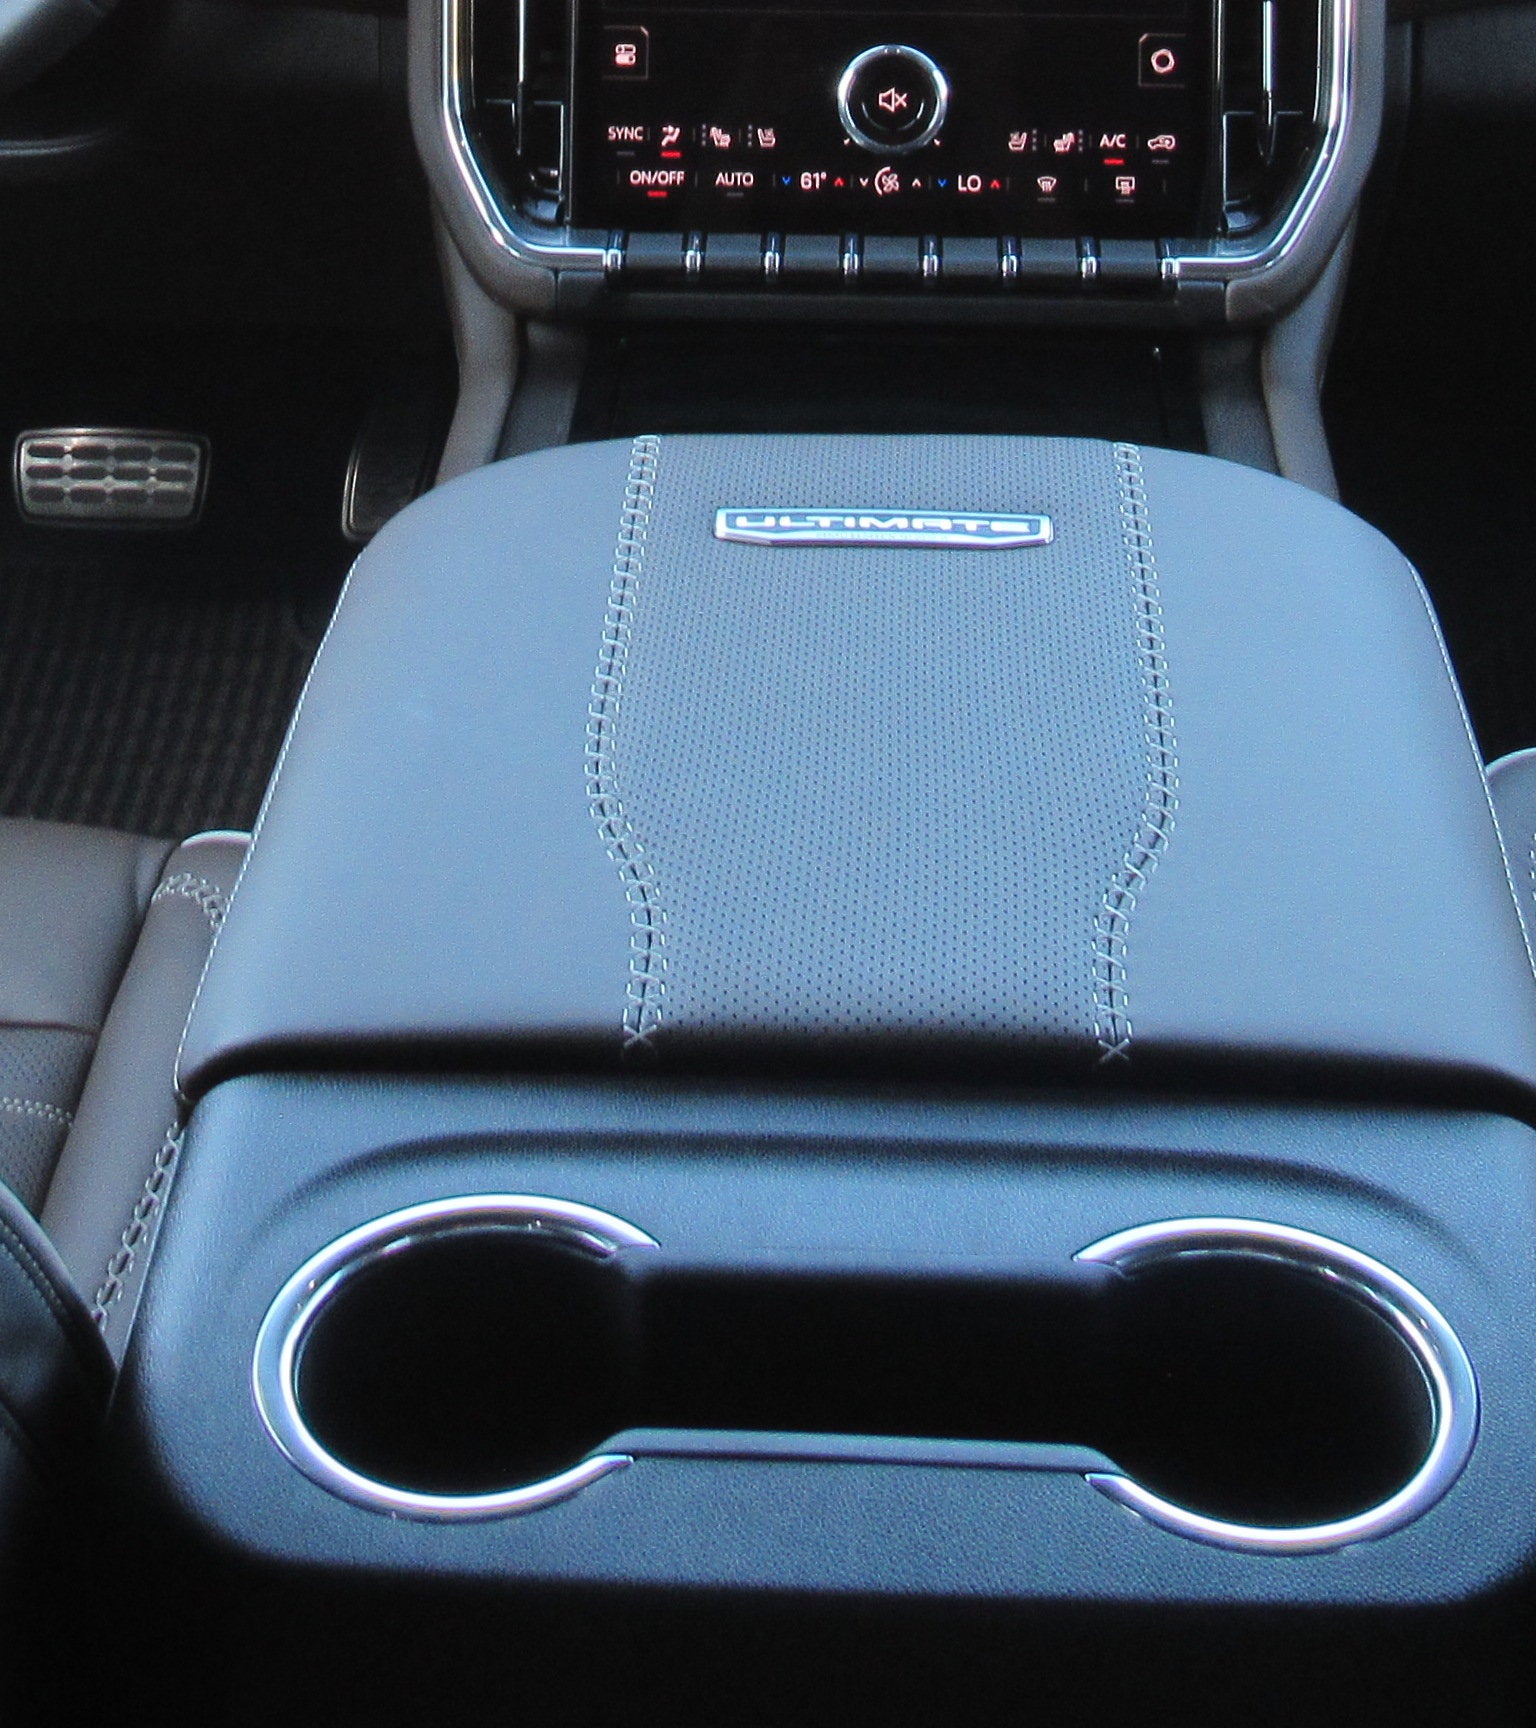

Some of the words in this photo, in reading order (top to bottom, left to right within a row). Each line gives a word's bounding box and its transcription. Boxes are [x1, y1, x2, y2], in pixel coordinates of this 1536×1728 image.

[607, 126, 644, 141] SYNC
[1099, 133, 1126, 149] A/C
[629, 169, 685, 186] ON/OFF
[715, 171, 754, 187] AUTO
[800, 171, 827, 191] 61°
[957, 174, 982, 192] LO
[735, 515, 1032, 534] ULTIMATE
